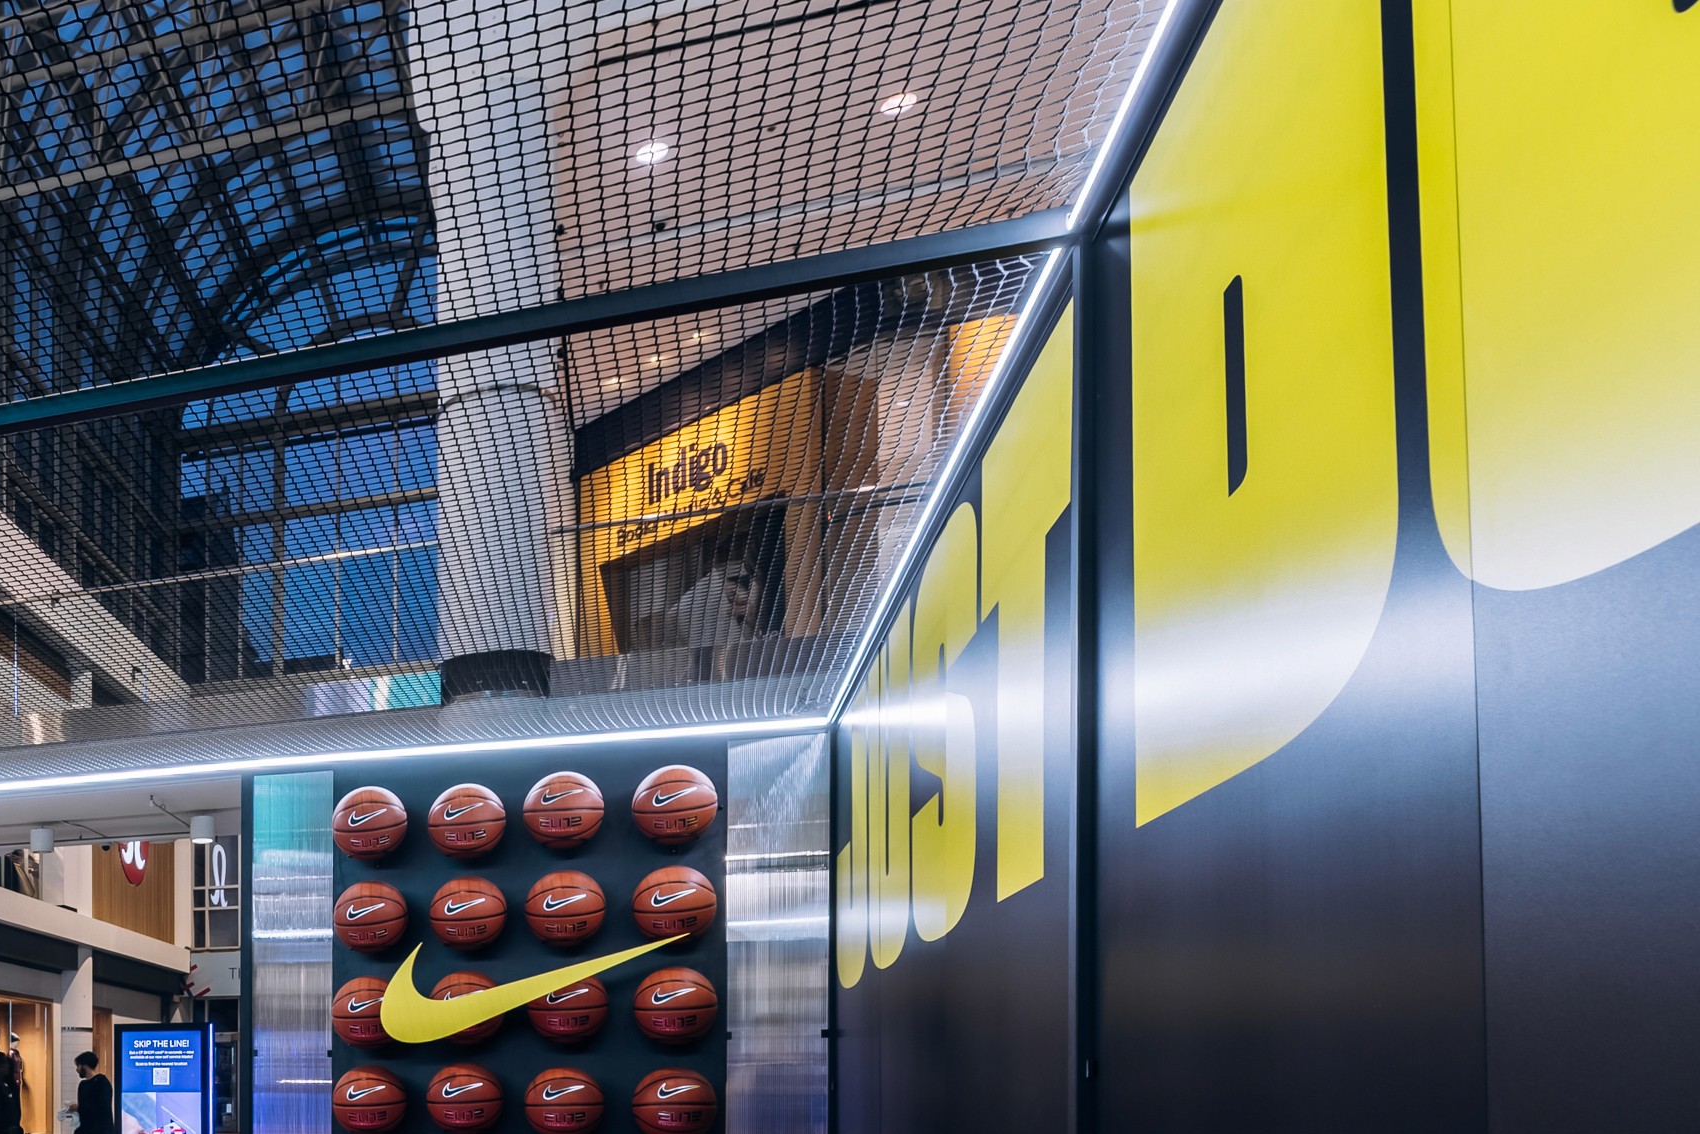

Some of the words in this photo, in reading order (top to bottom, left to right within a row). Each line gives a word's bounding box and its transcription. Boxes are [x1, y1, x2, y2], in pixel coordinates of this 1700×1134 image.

[647, 442, 728, 507] Indigo
[538, 816, 583, 828] ELITE
[653, 816, 698, 829] ELITE
[445, 829, 486, 842] ELITE
[544, 921, 588, 934] ELITE
[652, 916, 698, 930] ELITE
[445, 924, 487, 936] ELITE
[547, 1014, 590, 1026] ELITE
[652, 1014, 698, 1027] ELITE
[133, 1039, 152, 1048] SKIP
[152, 1039, 168, 1048] THE
[443, 1108, 485, 1120] ELITE
[543, 1111, 587, 1123] ELITE
